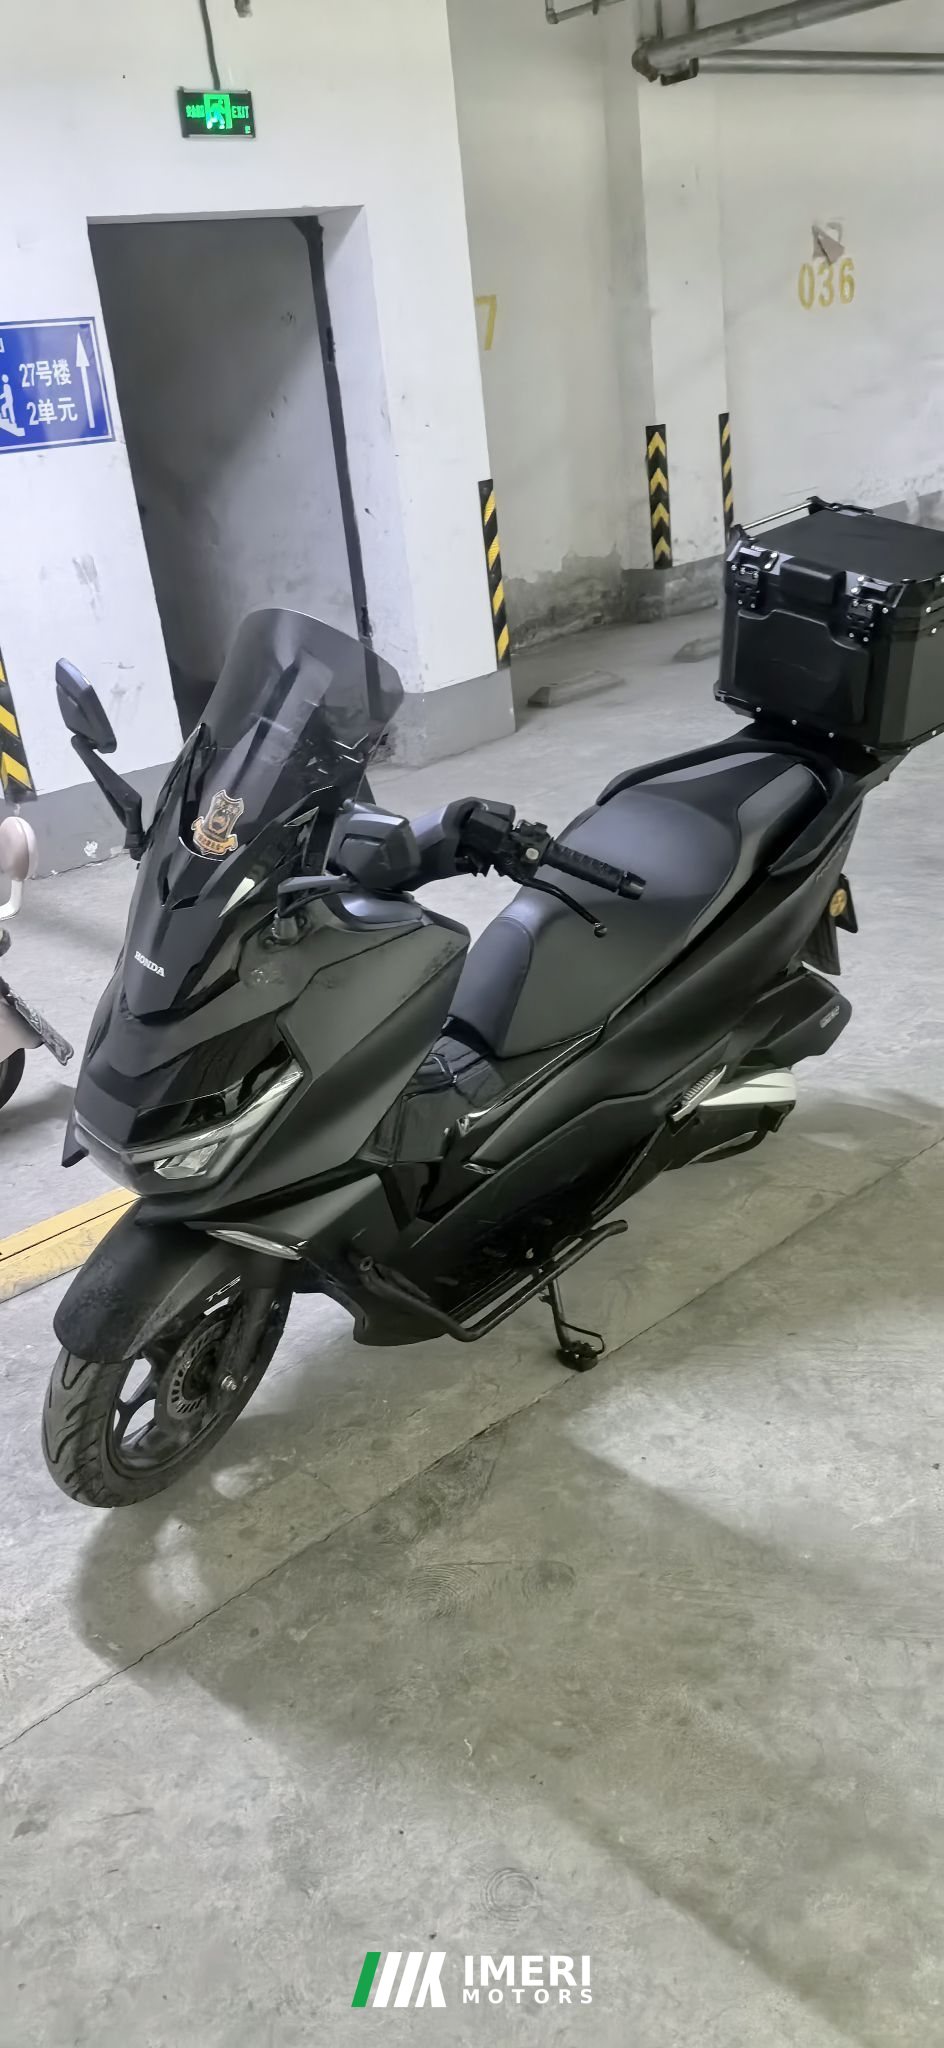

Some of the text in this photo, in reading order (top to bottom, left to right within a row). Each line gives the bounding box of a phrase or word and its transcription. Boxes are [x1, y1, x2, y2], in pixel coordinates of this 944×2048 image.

[231, 105, 249, 119] EXIT
[799, 257, 855, 310] 036
[19, 358, 72, 388] 27号楼
[26, 397, 78, 426] 2单元
[134, 950, 166, 978] HONDA
